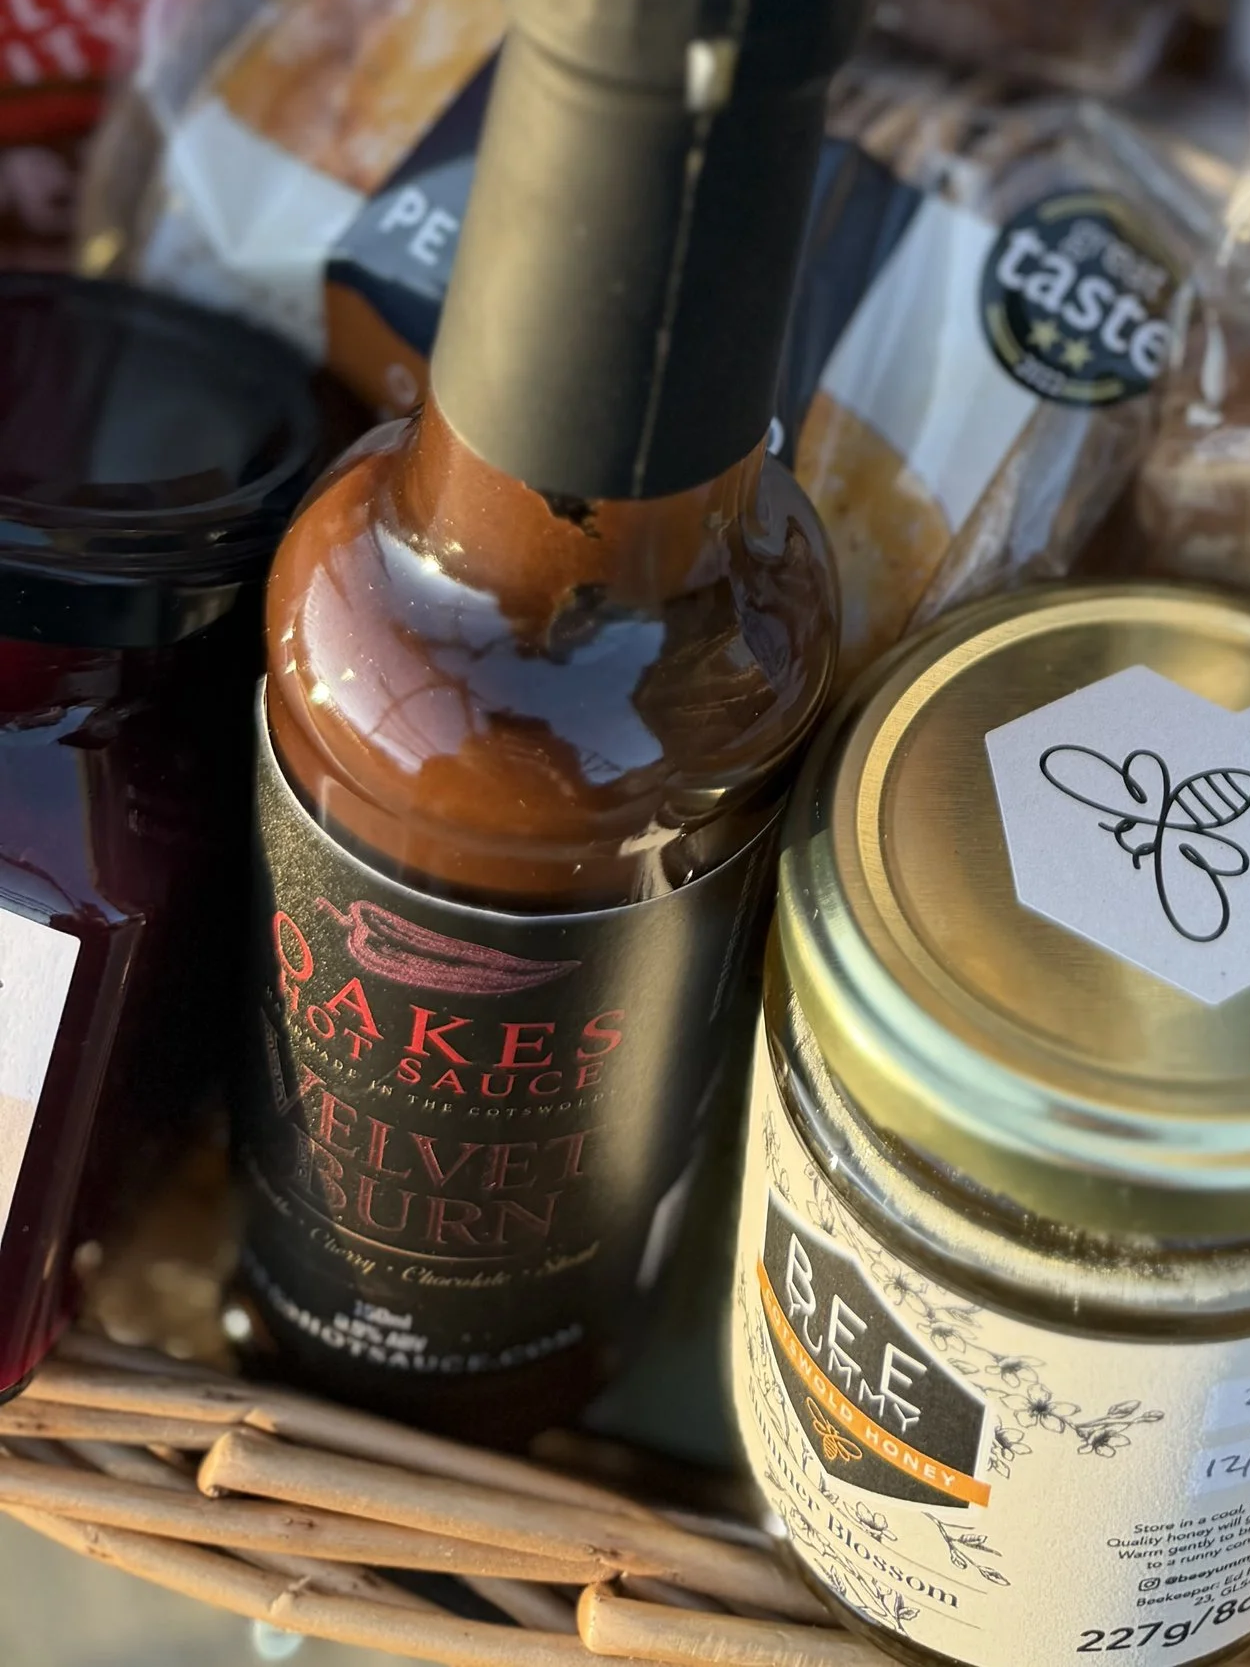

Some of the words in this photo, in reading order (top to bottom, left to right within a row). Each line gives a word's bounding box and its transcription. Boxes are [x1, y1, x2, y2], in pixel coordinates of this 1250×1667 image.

[997, 228, 1174, 378] taste
[273, 910, 627, 1069] OAKES
[396, 1058, 605, 1099] SAUCE
[407, 1094, 453, 1114] THE
[785, 1232, 929, 1417] BEE
[864, 1424, 957, 1488] HONEY
[1106, 1536, 1163, 1548] Quality
[1167, 1527, 1214, 1543] honey
[1218, 1515, 1242, 1531] will
[1133, 1522, 1175, 1535] Store
[1179, 1518, 1194, 1529] in
[826, 1512, 961, 1609] Blossom
[1118, 1549, 1163, 1560] Warm
[1168, 1538, 1216, 1556] gently
[1219, 1531, 1235, 1543] to
[1146, 1560, 1163, 1570] to
[1180, 1548, 1222, 1565] runny
[1224, 1569, 1244, 1586] Ed
